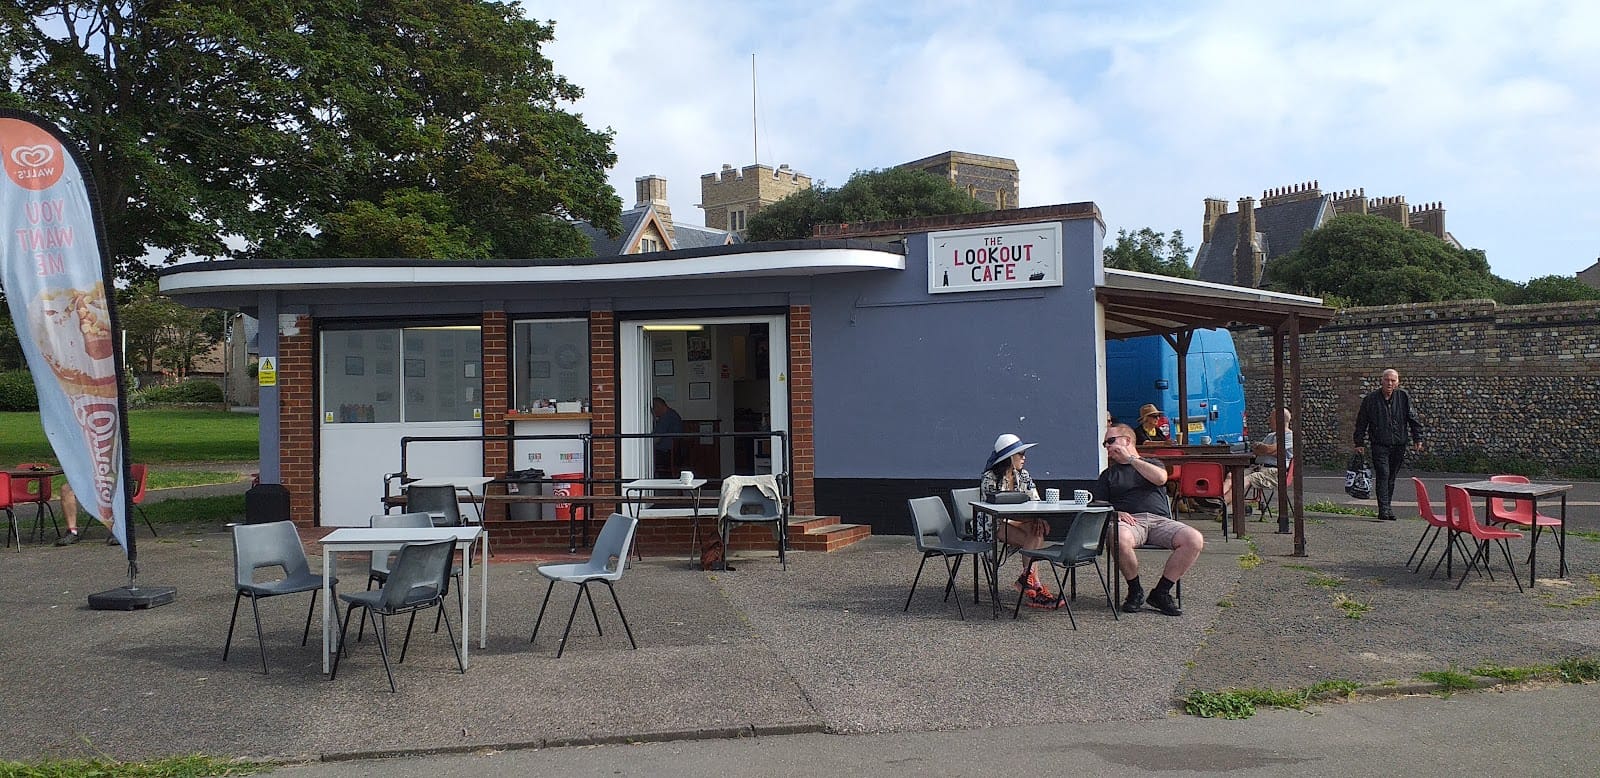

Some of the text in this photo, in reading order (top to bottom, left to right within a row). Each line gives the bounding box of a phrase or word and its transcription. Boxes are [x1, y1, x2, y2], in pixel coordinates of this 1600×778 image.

[984, 236, 1003, 246] THE
[954, 244, 1033, 266] LOOKOUT
[971, 264, 1016, 282] CAFE
